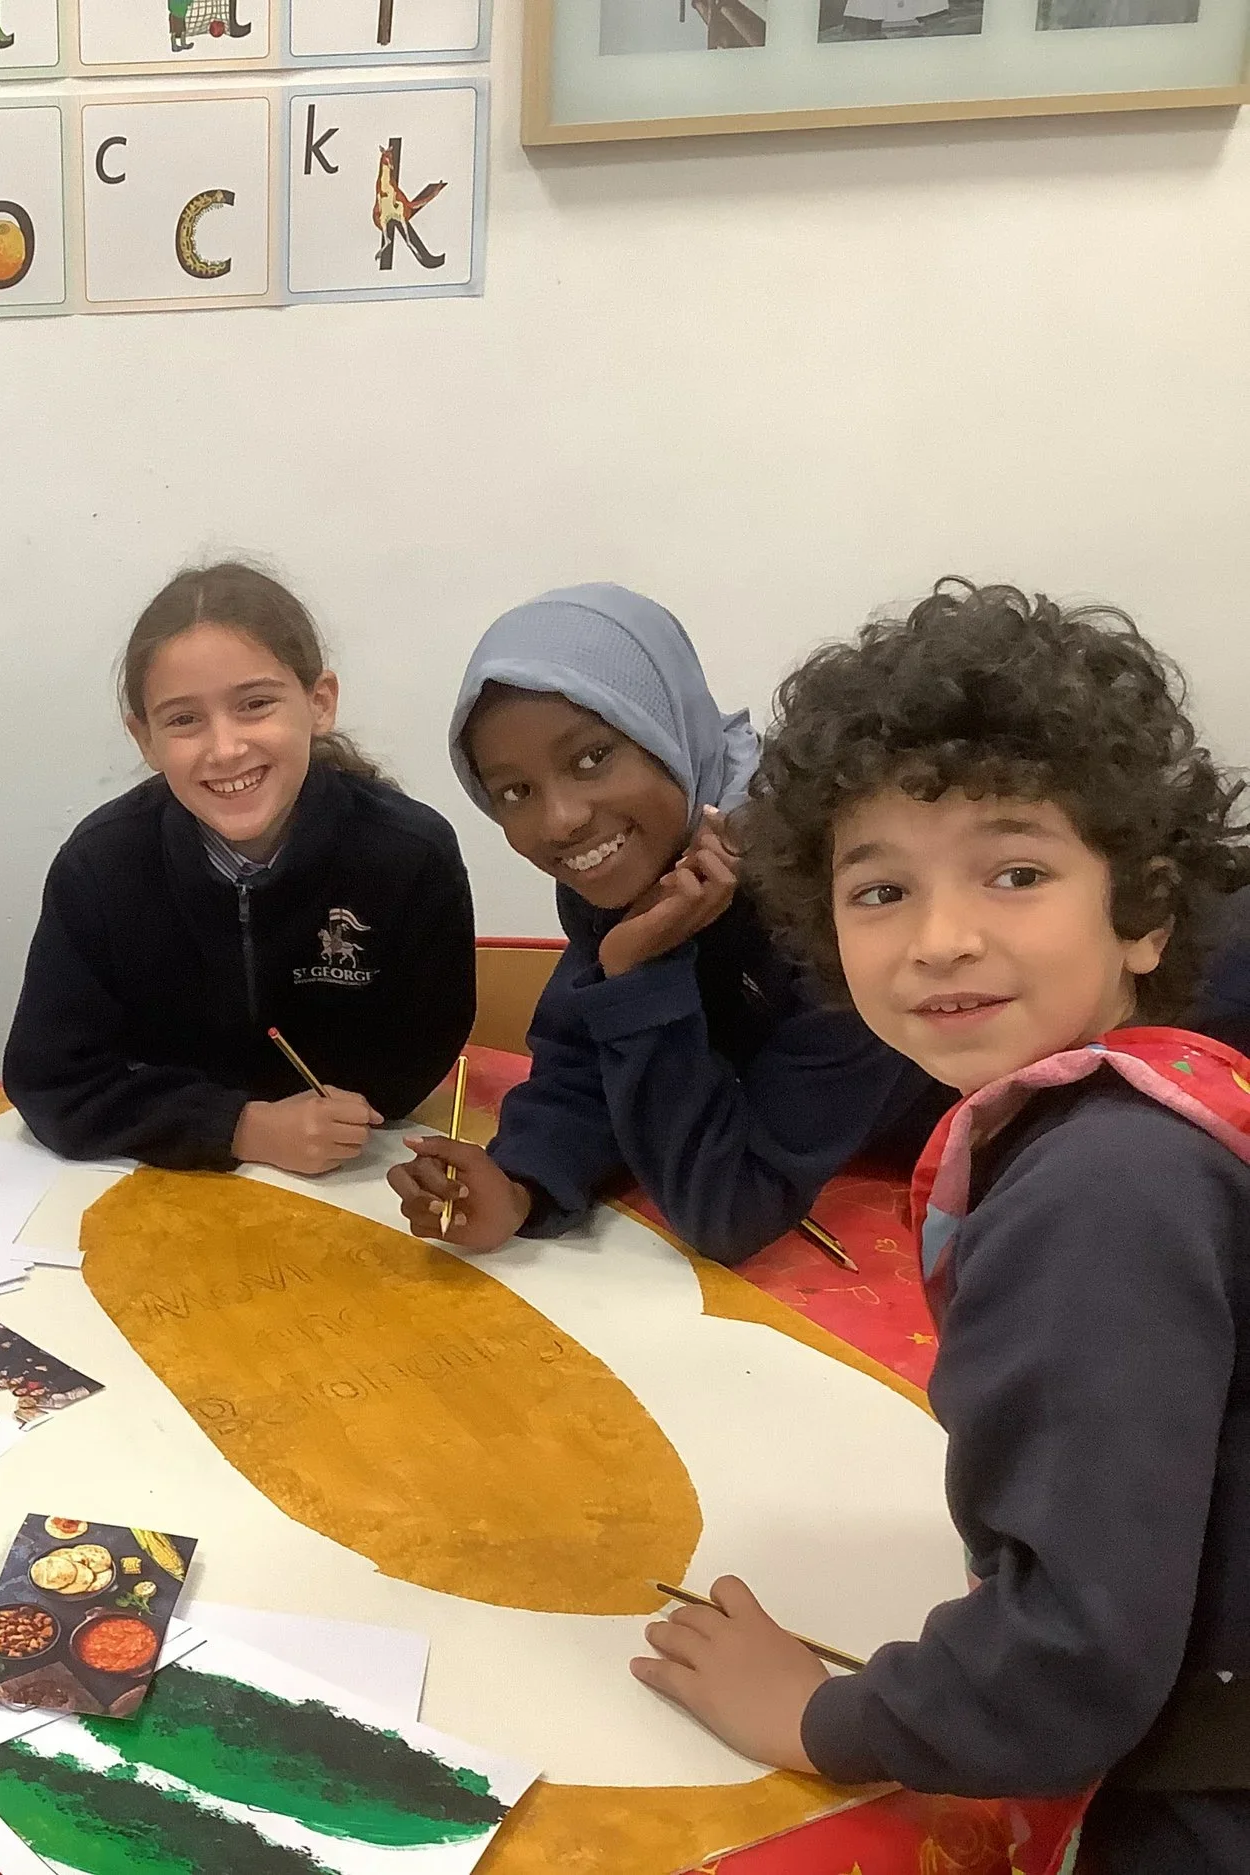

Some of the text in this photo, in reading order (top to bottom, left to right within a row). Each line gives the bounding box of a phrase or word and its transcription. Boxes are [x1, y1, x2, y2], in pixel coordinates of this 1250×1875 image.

[95, 136, 127, 185] c
[302, 104, 339, 176] k
[175, 189, 235, 280] c
